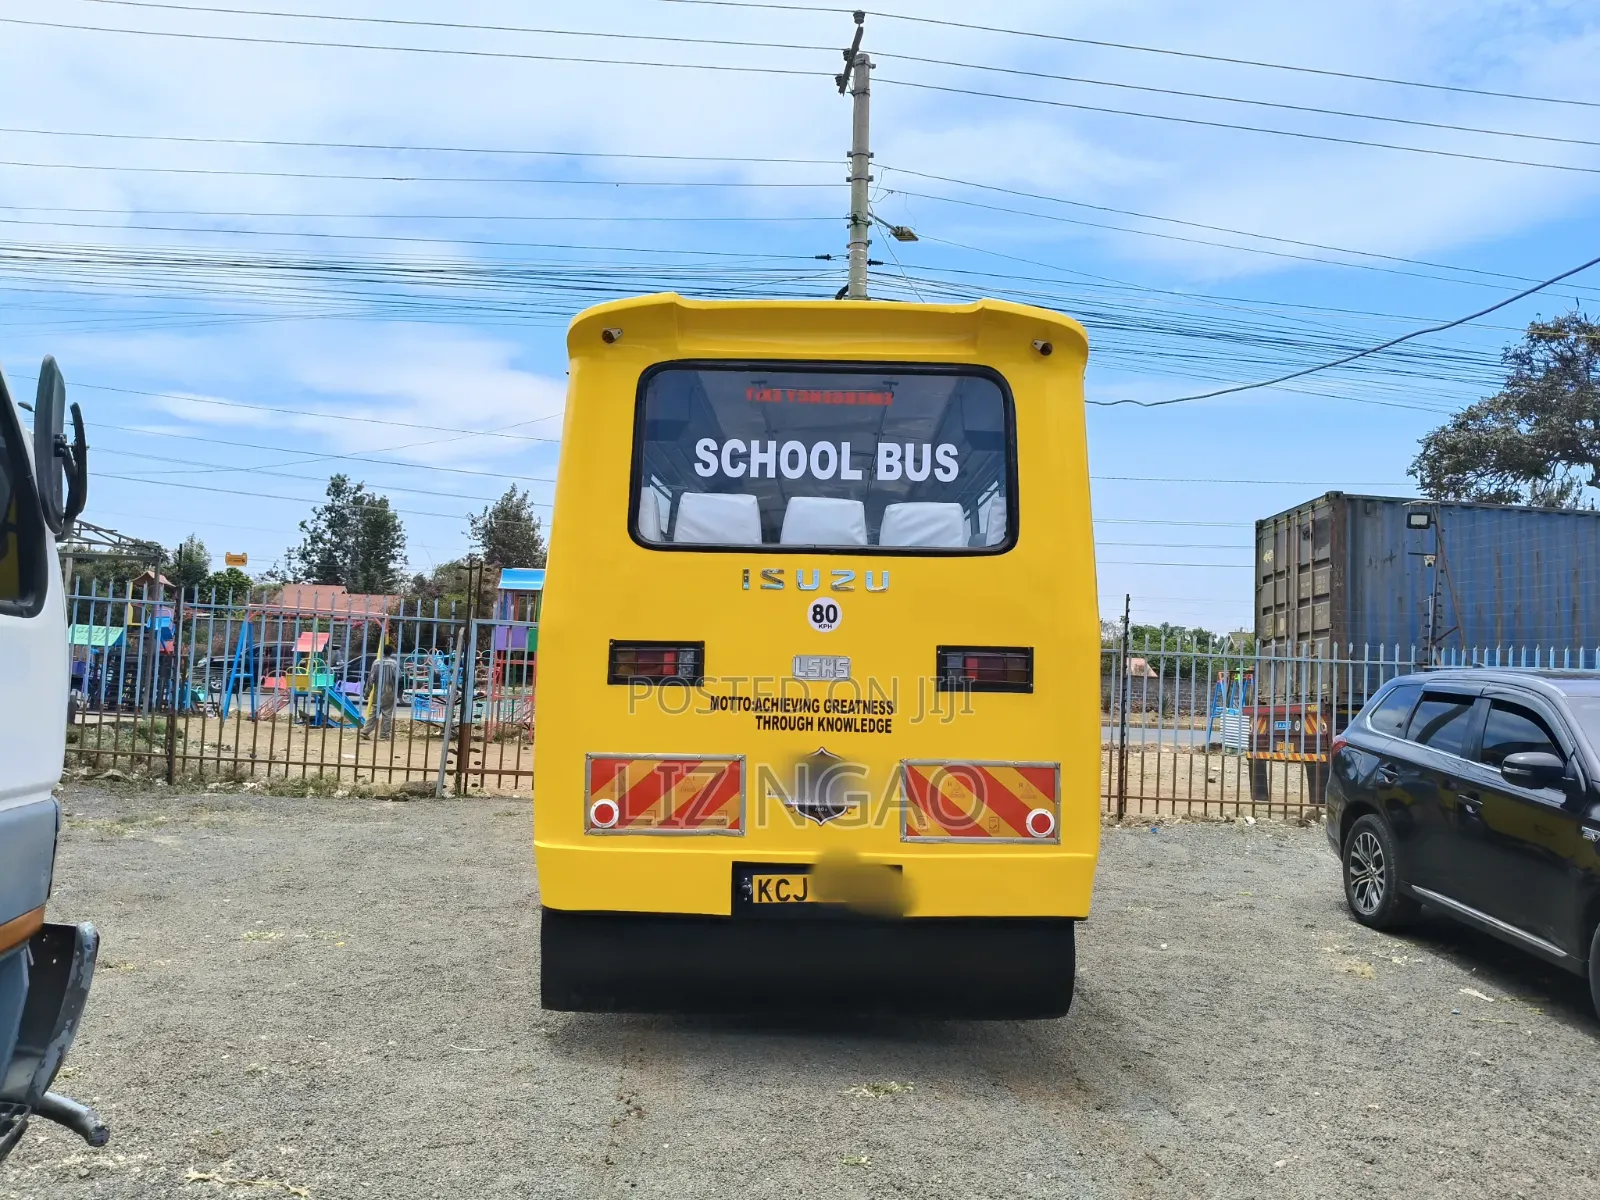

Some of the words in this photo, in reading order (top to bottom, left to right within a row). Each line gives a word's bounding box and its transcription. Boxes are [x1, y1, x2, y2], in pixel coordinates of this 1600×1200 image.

[694, 438, 862, 480] SCHOOL
[877, 442, 959, 482] BUS
[742, 569, 890, 593] ISUZU
[812, 604, 838, 624] 80
[824, 699, 894, 715] GREATNESS
[756, 715, 814, 731] THROUGH
[818, 717, 892, 733] KNOWLEDGE
[758, 878, 808, 902] KCJ
